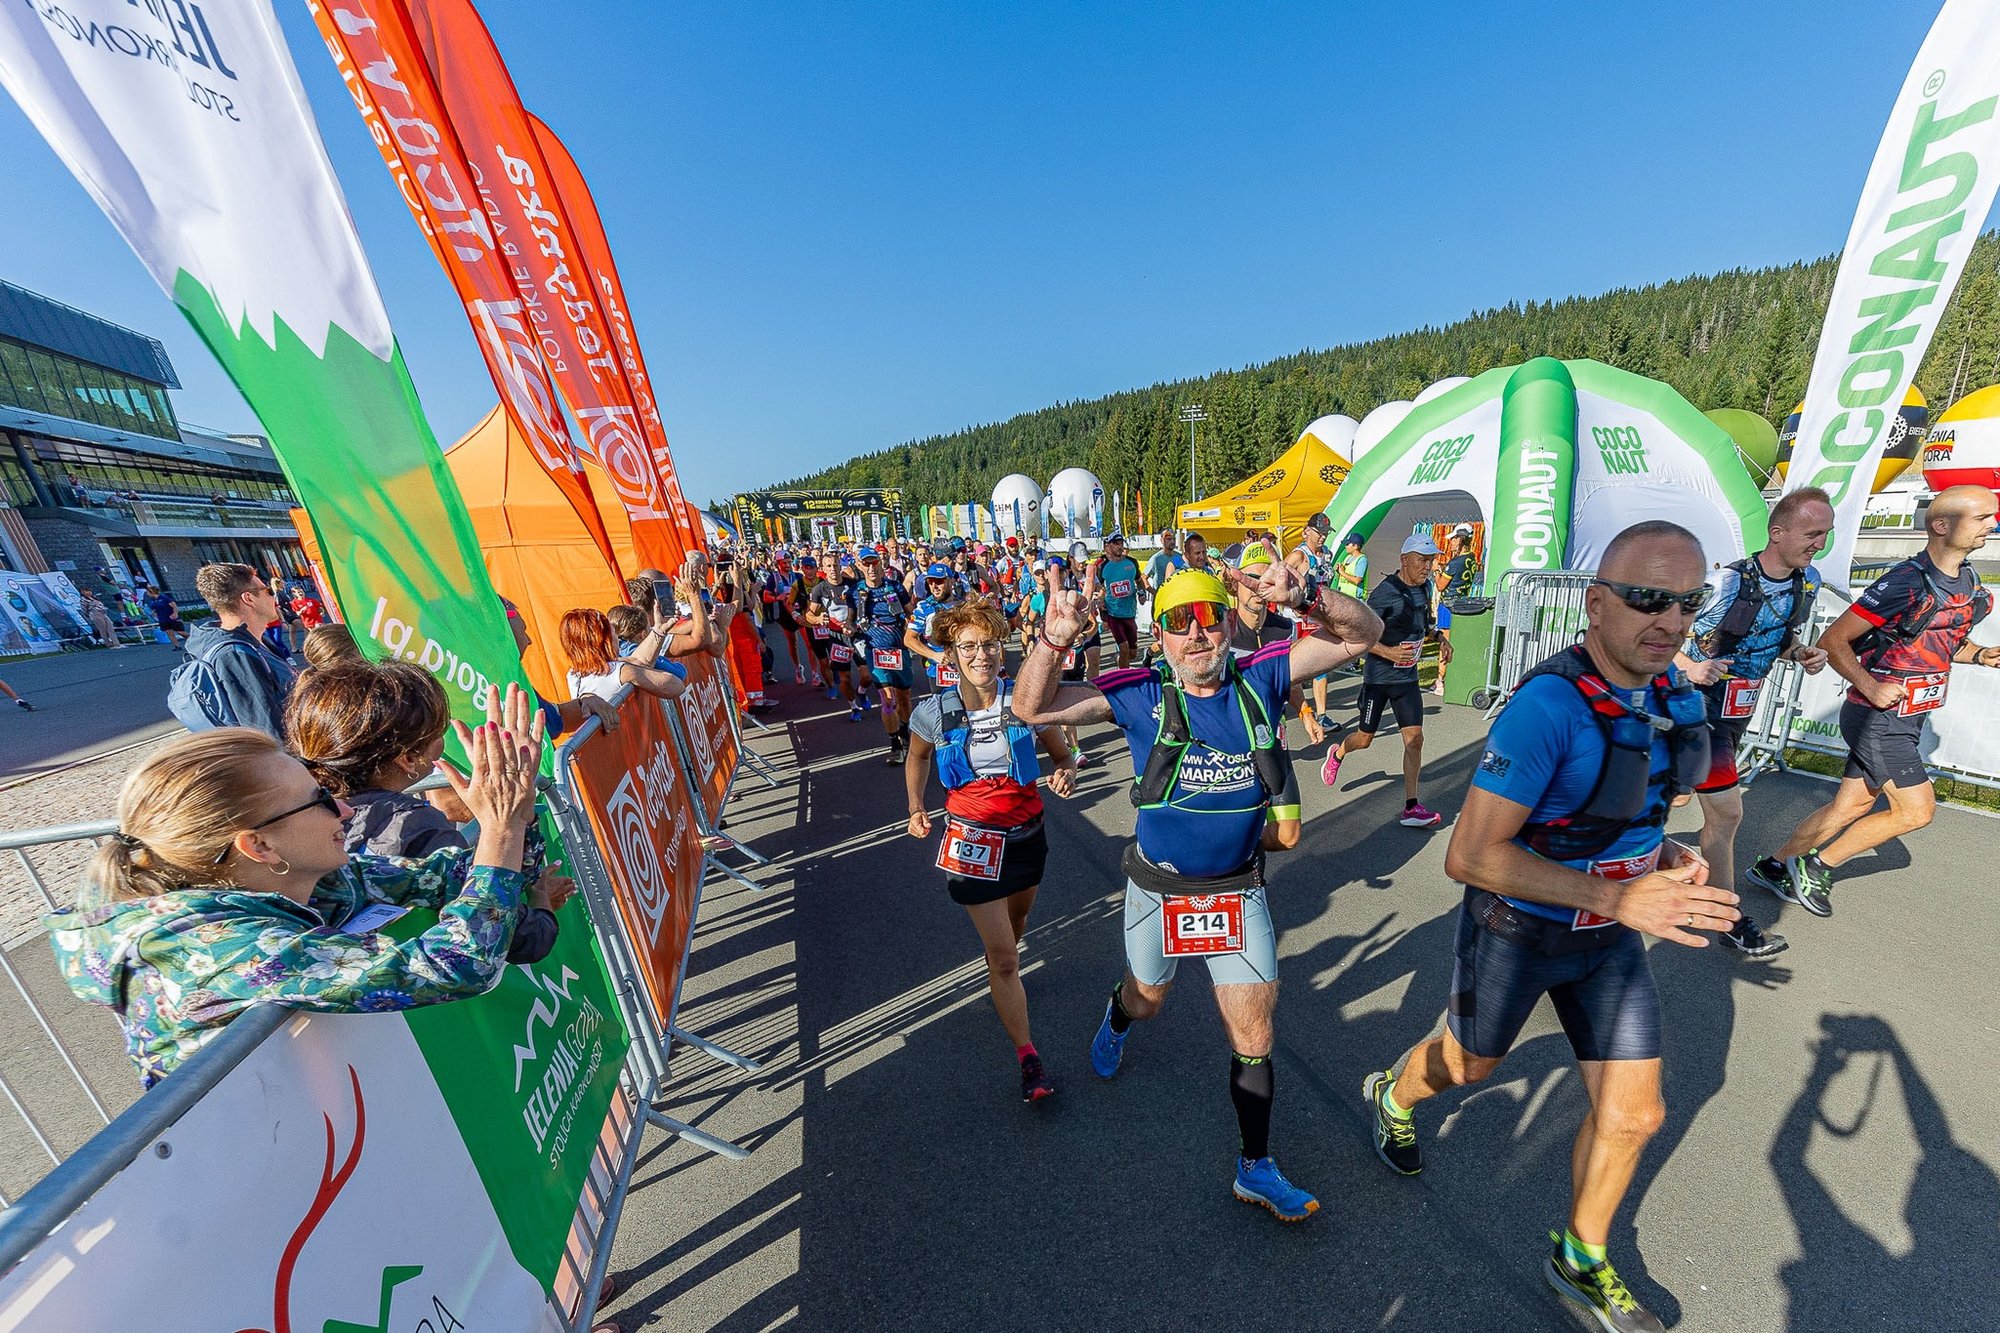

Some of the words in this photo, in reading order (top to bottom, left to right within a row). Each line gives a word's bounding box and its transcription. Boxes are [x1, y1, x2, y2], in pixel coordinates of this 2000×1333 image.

[1422, 433, 1475, 463] COCO
[1592, 425, 1643, 451] COCO
[1407, 457, 1461, 486] NAUT
[1600, 449, 1650, 475] NAUT
[1510, 448, 1559, 569] CONAUT
[1922, 687, 1939, 699] 73
[1180, 763, 1255, 783] MARATON
[954, 840, 987, 860] 137
[1182, 914, 1226, 932] 214
[522, 1039, 579, 1154] JELENIA
[550, 1109, 573, 1170] STOLICA
